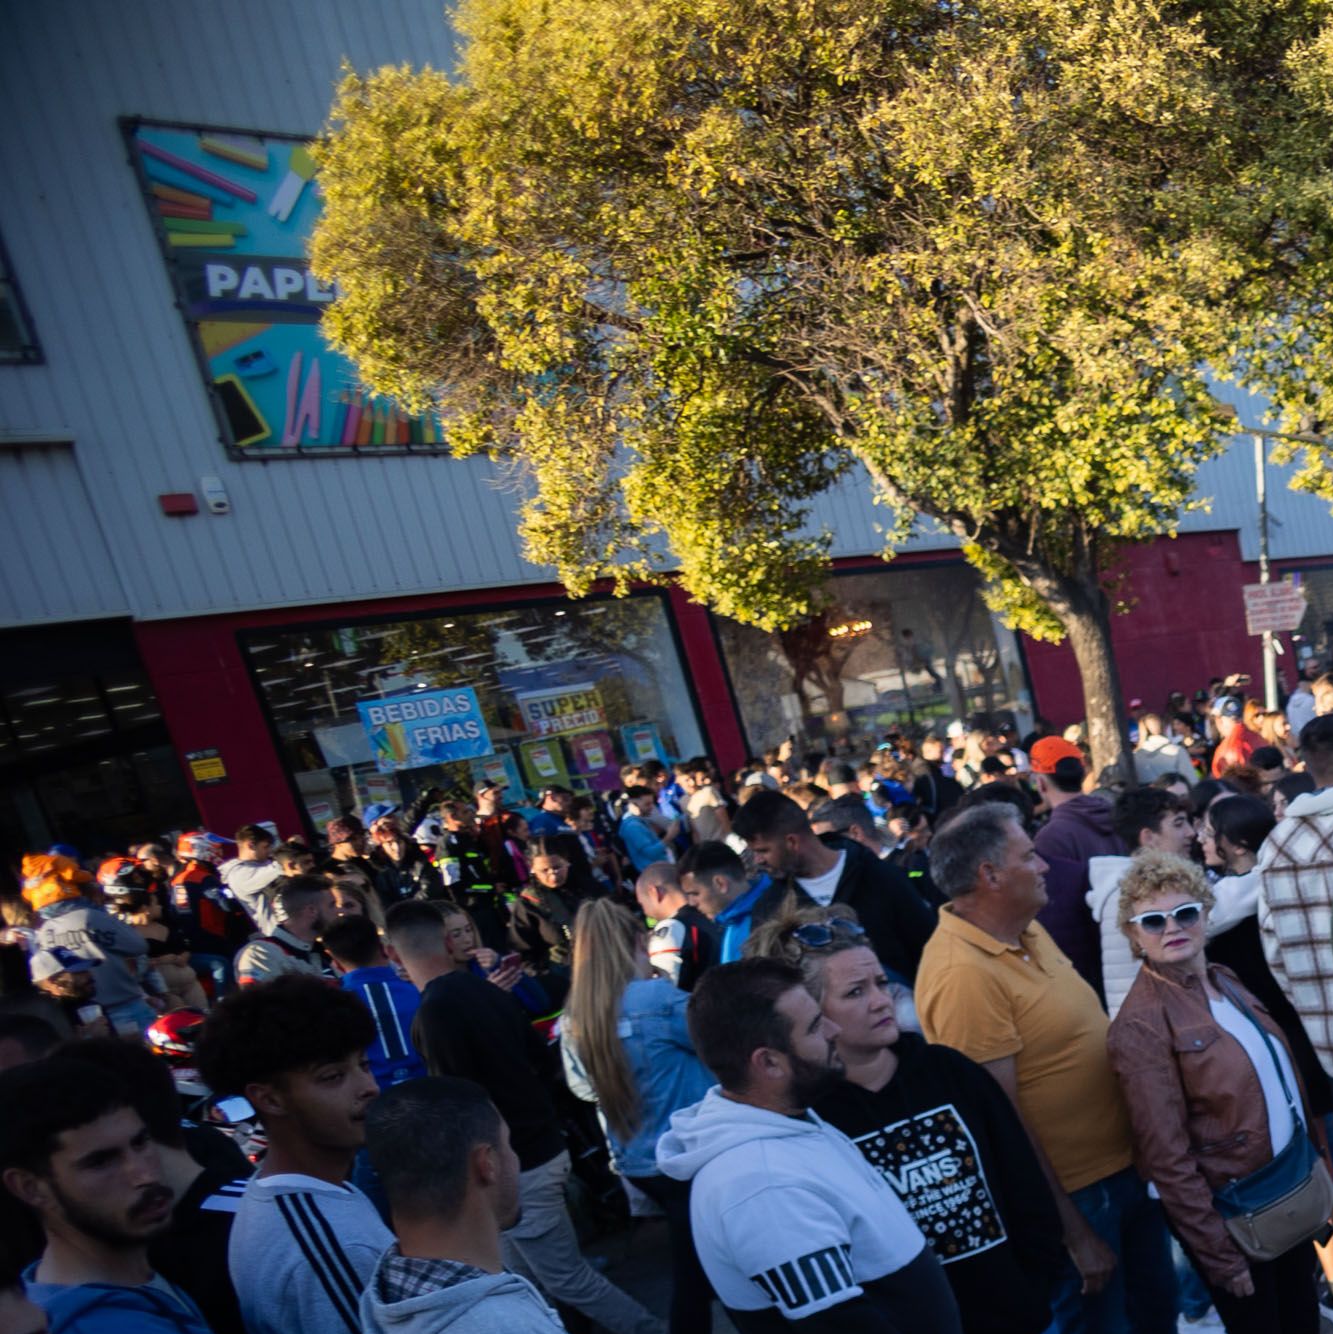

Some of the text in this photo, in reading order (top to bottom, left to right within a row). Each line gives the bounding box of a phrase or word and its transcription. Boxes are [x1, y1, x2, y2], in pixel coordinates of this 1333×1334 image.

[206, 264, 337, 301] PAPE
[368, 694, 472, 726] BEBIDAS
[527, 692, 599, 722] SUPER
[541, 709, 600, 735] PRECIO
[413, 721, 481, 747] FRIAS
[884, 1149, 958, 1194] VANS
